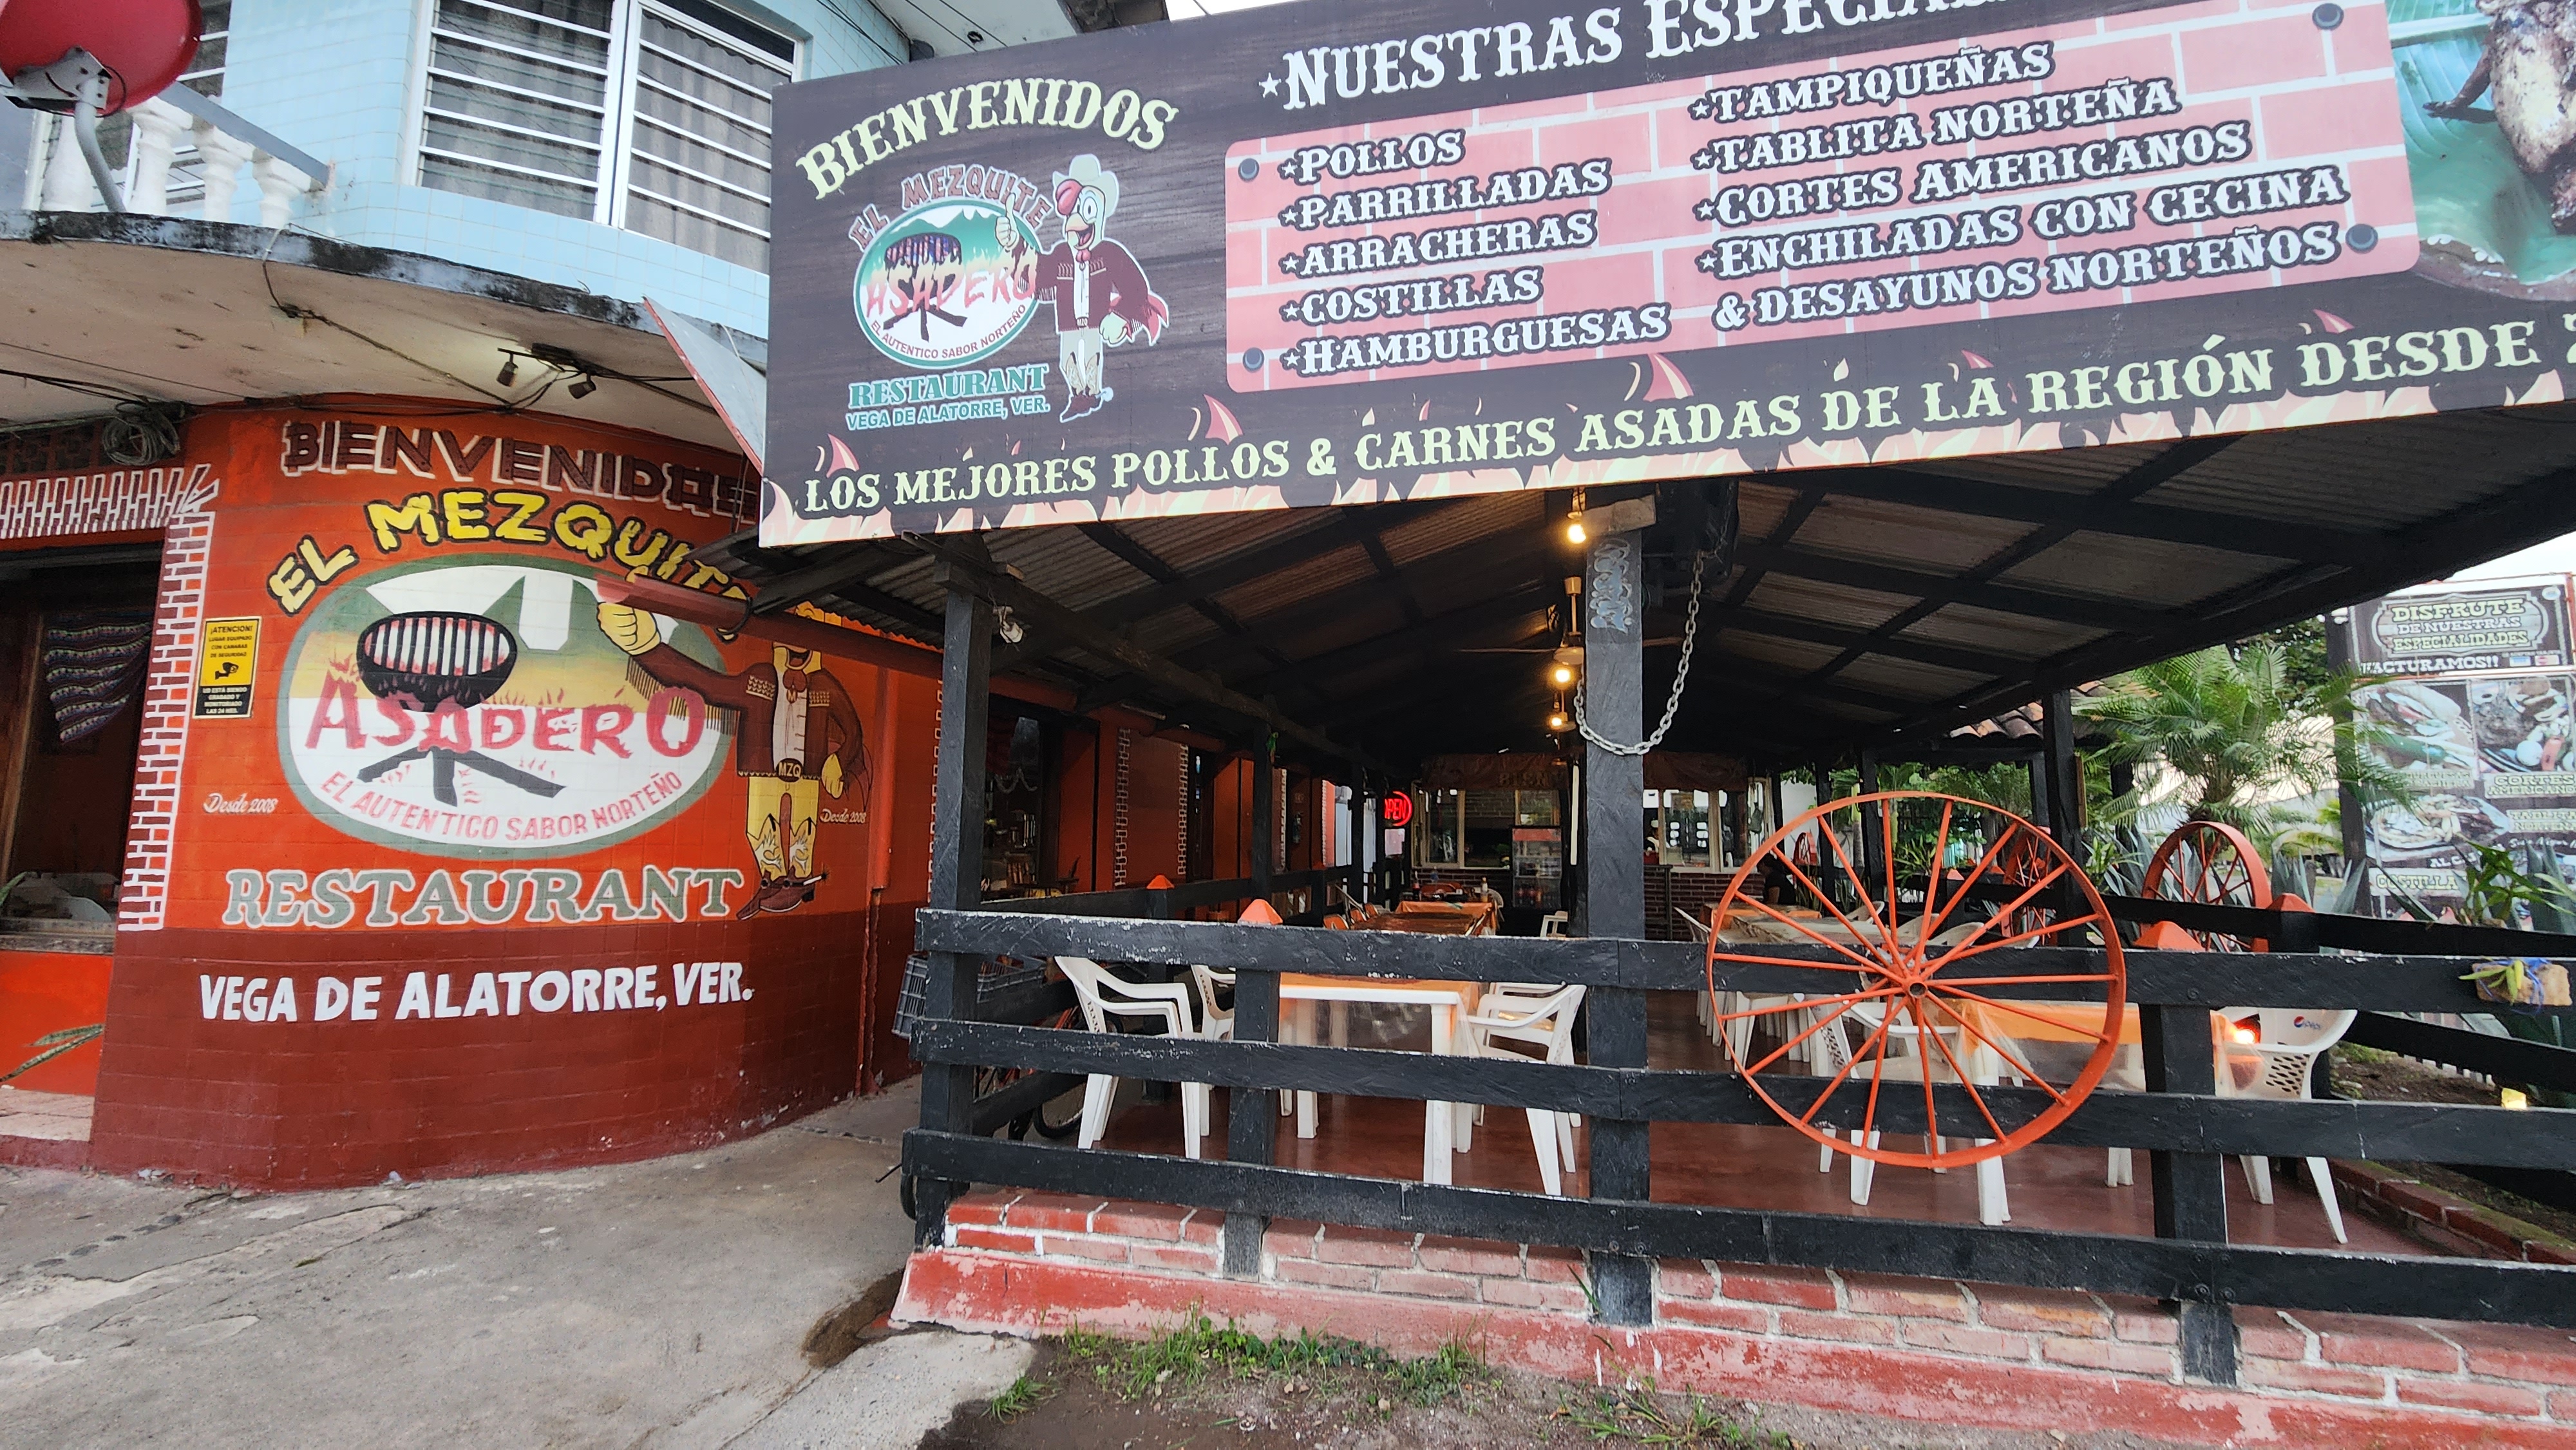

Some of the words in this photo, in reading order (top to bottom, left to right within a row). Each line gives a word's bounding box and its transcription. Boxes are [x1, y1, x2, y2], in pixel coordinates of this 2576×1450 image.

[1283, 8, 1623, 109] NUESTRAS
[1710, 42, 2050, 121] TAMPIQUEÑAS
[796, 78, 1179, 200] BIENVENIDOS
[1713, 116, 1922, 171] TABLITA
[1935, 77, 2178, 142] NORTEÑA
[1298, 132, 1463, 183] POLLOS
[1716, 170, 1898, 225] CORTES
[1912, 122, 2248, 200] AMERICANOS
[849, 205, 889, 251] EL
[902, 164, 1054, 229] MEZQUITE
[1299, 160, 1610, 228] PARRILLADAS
[1718, 209, 2019, 277] ENCHILADAS
[2032, 194, 2132, 237] CON
[2148, 168, 2346, 223] CECINA
[1303, 212, 1595, 276] ARRACHERAS
[866, 246, 1038, 317] ASADERO
[1302, 268, 1541, 323] COSTILLAS
[1716, 295, 1747, 328] &
[1757, 261, 2036, 323] DESAYUNOS
[2052, 225, 2336, 290] NORTEÑOS
[871, 320, 882, 335] EL
[882, 333, 938, 359] AUTENTICO
[942, 342, 979, 359] SABOR
[981, 304, 1026, 348] NORTEÑO
[1299, 305, 1669, 375] HAMBURGUESAS
[805, 473, 879, 513] LOS
[894, 455, 1096, 505] MEJORES
[1112, 441, 1289, 488] POLLOS
[1307, 438, 1336, 476] &
[1355, 417, 1556, 471] CARNES
[1575, 394, 1802, 452] ASADAS
[1823, 386, 1901, 432] DE
[1923, 377, 2002, 422] LA
[2027, 334, 2274, 413] REGIÓN
[2300, 321, 2543, 388] DESDE
[848, 409, 890, 429] VEGA
[894, 406, 915, 425] DE
[919, 399, 1008, 422] ALATORRE,
[1012, 395, 1050, 414] VER.
[849, 364, 1049, 408] RESTAURANT
[280, 420, 757, 525] BIENVENIDOS
[267, 536, 359, 614] EL
[365, 488, 749, 602] MEZQUIT
[2392, 598, 2525, 622] DISFRUTE
[2393, 630, 2530, 652] ESPECIALIDADES
[2398, 624, 2421, 635] DE
[2424, 616, 2521, 634] NUESTRAS
[305, 663, 705, 757] ASADERO
[779, 761, 802, 778] MZQ
[2488, 785, 2576, 795] AMERICANO
[2495, 775, 2575, 786] CORTES
[203, 793, 248, 813] Desde
[247, 798, 279, 813] 2008
[321, 771, 352, 804] EL
[351, 789, 498, 840] AUTENTICO
[505, 814, 587, 841] SABOR
[591, 771, 683, 829] NORTEÑO
[820, 808, 849, 824] Desde
[849, 812, 867, 824] 2008
[223, 867, 744, 928] RESTAURANT
[2377, 874, 2466, 890] COSTILLA
[200, 974, 297, 1022] VEGA
[314, 976, 381, 1021] DE
[395, 964, 667, 1020] ALATORRE,
[672, 962, 753, 1006] VER.
